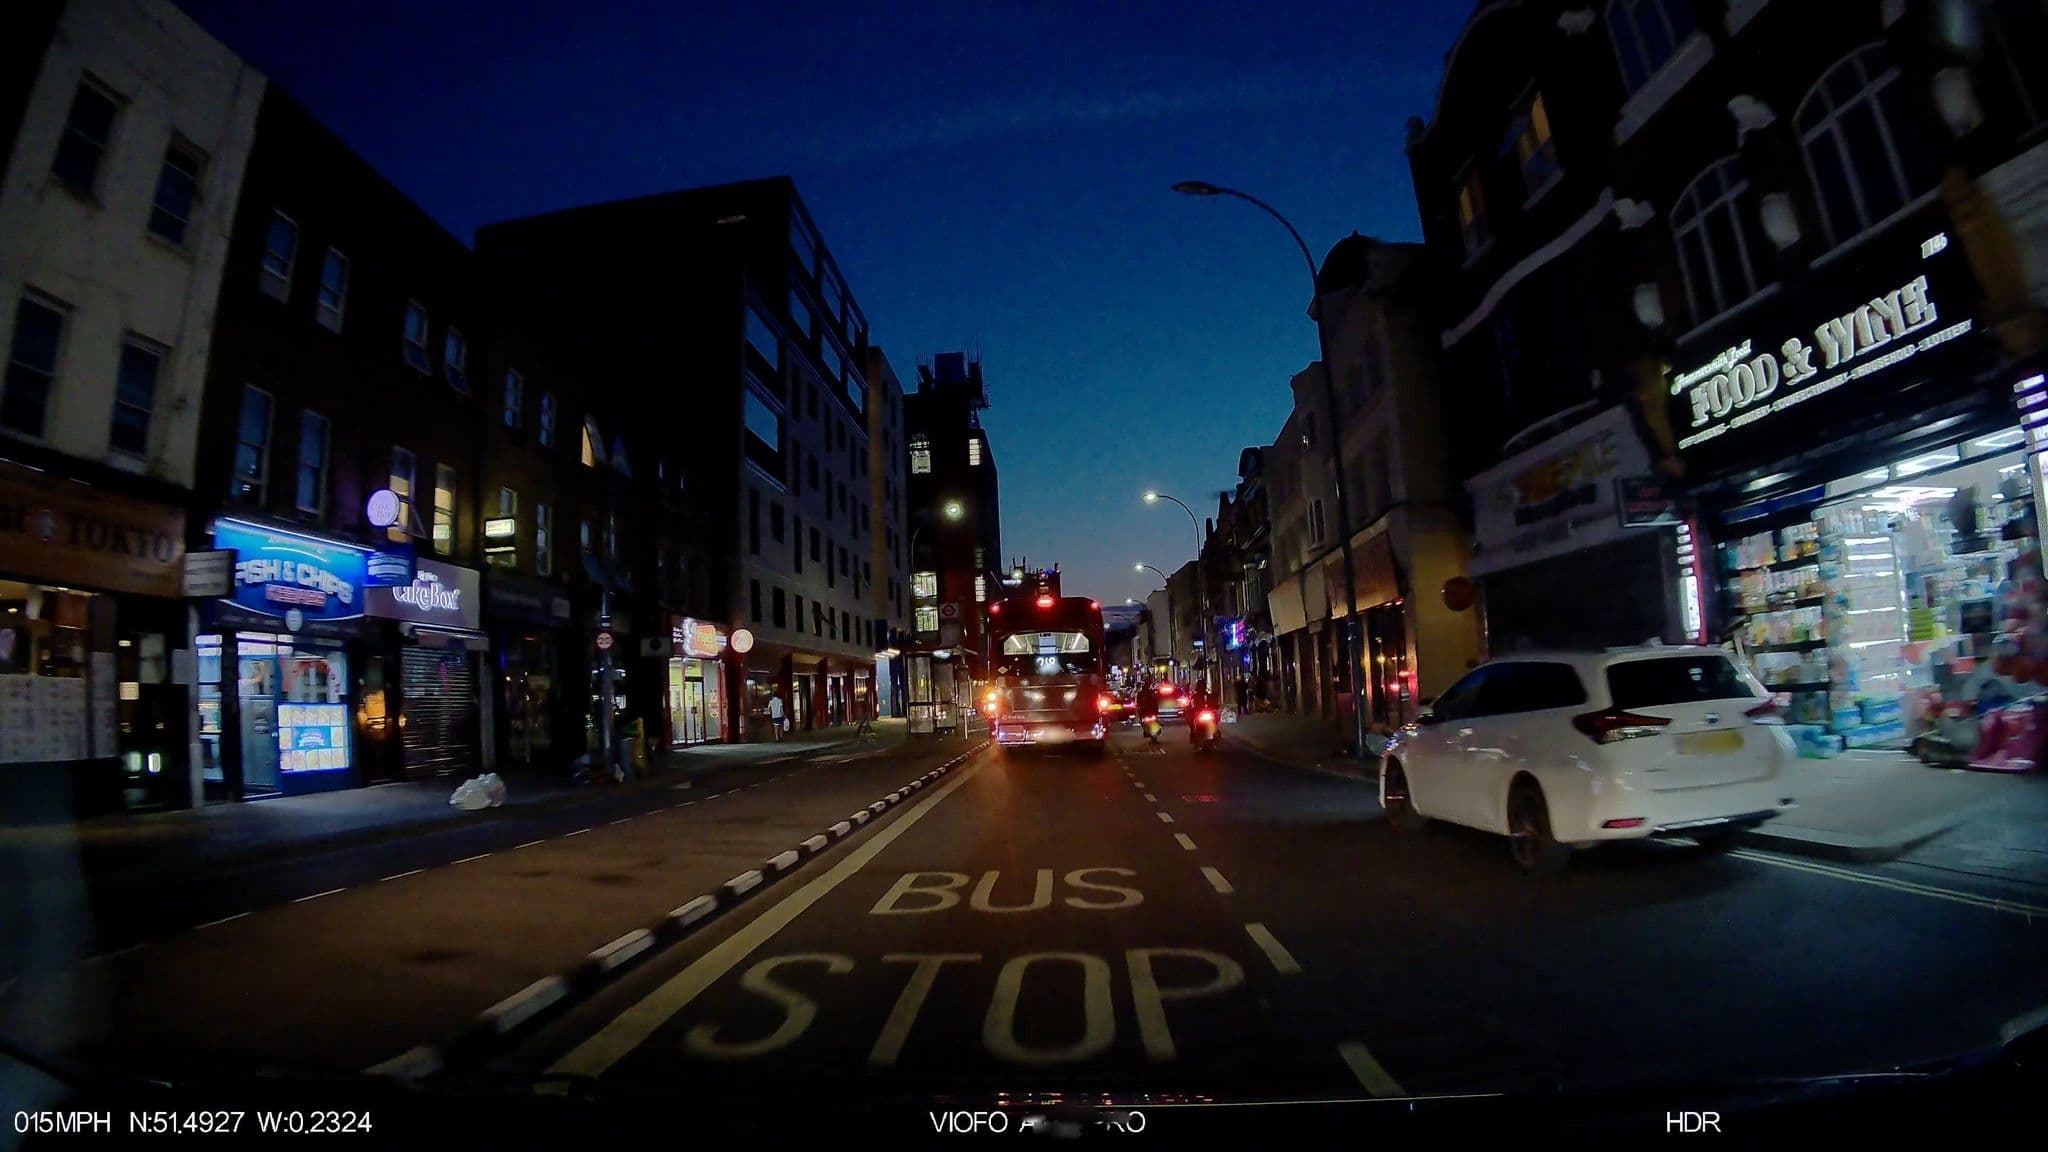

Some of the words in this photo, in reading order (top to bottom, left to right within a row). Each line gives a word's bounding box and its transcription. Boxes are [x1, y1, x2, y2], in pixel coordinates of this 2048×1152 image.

[1690, 353, 1779, 427] FOOD
[1781, 337, 1817, 386] &
[1814, 274, 1938, 369] WINE
[69, 511, 178, 565] TOKYO
[283, 560, 296, 582] &
[868, 867, 1145, 915] BUS
[683, 946, 1246, 1068] STOP
